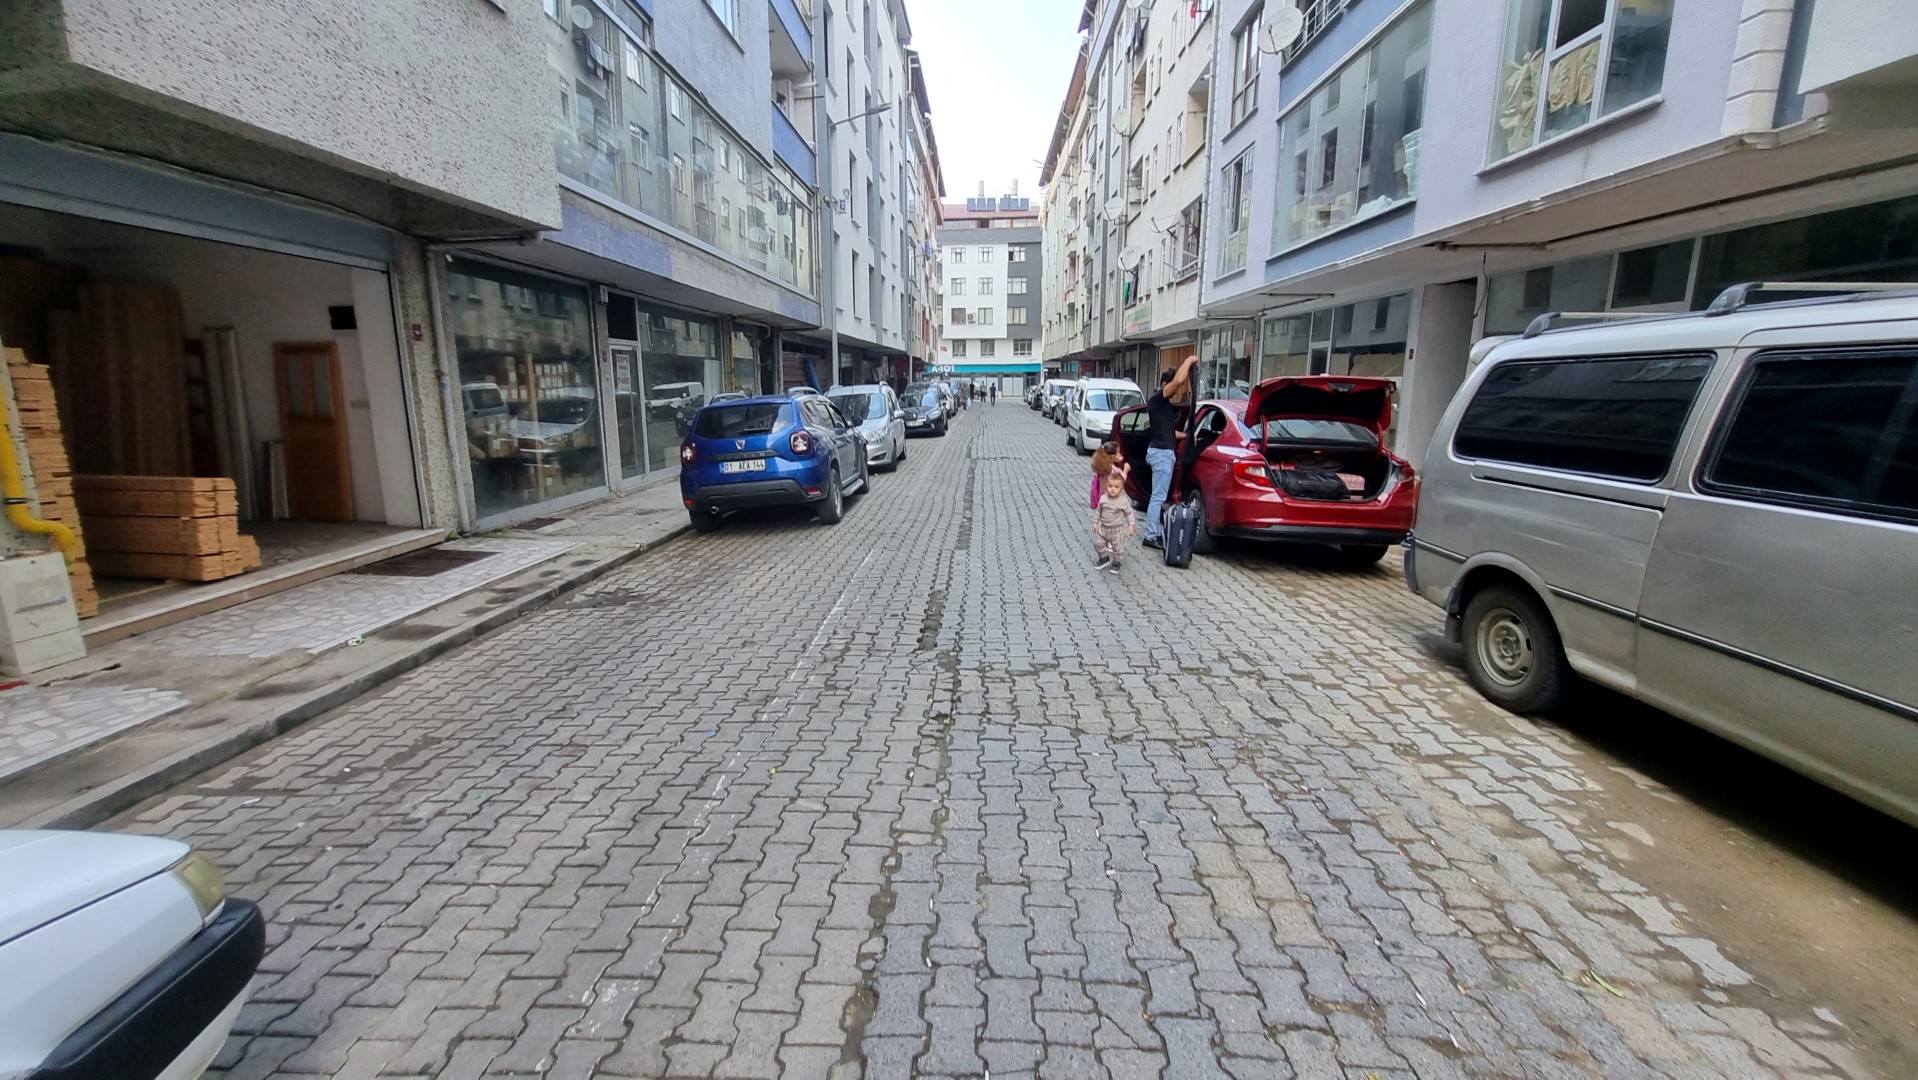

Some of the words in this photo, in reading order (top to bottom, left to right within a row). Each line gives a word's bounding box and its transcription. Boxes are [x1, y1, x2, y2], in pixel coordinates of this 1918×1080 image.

[724, 463, 733, 472] 01
[738, 461, 751, 470] AEA
[753, 460, 765, 469] 144
